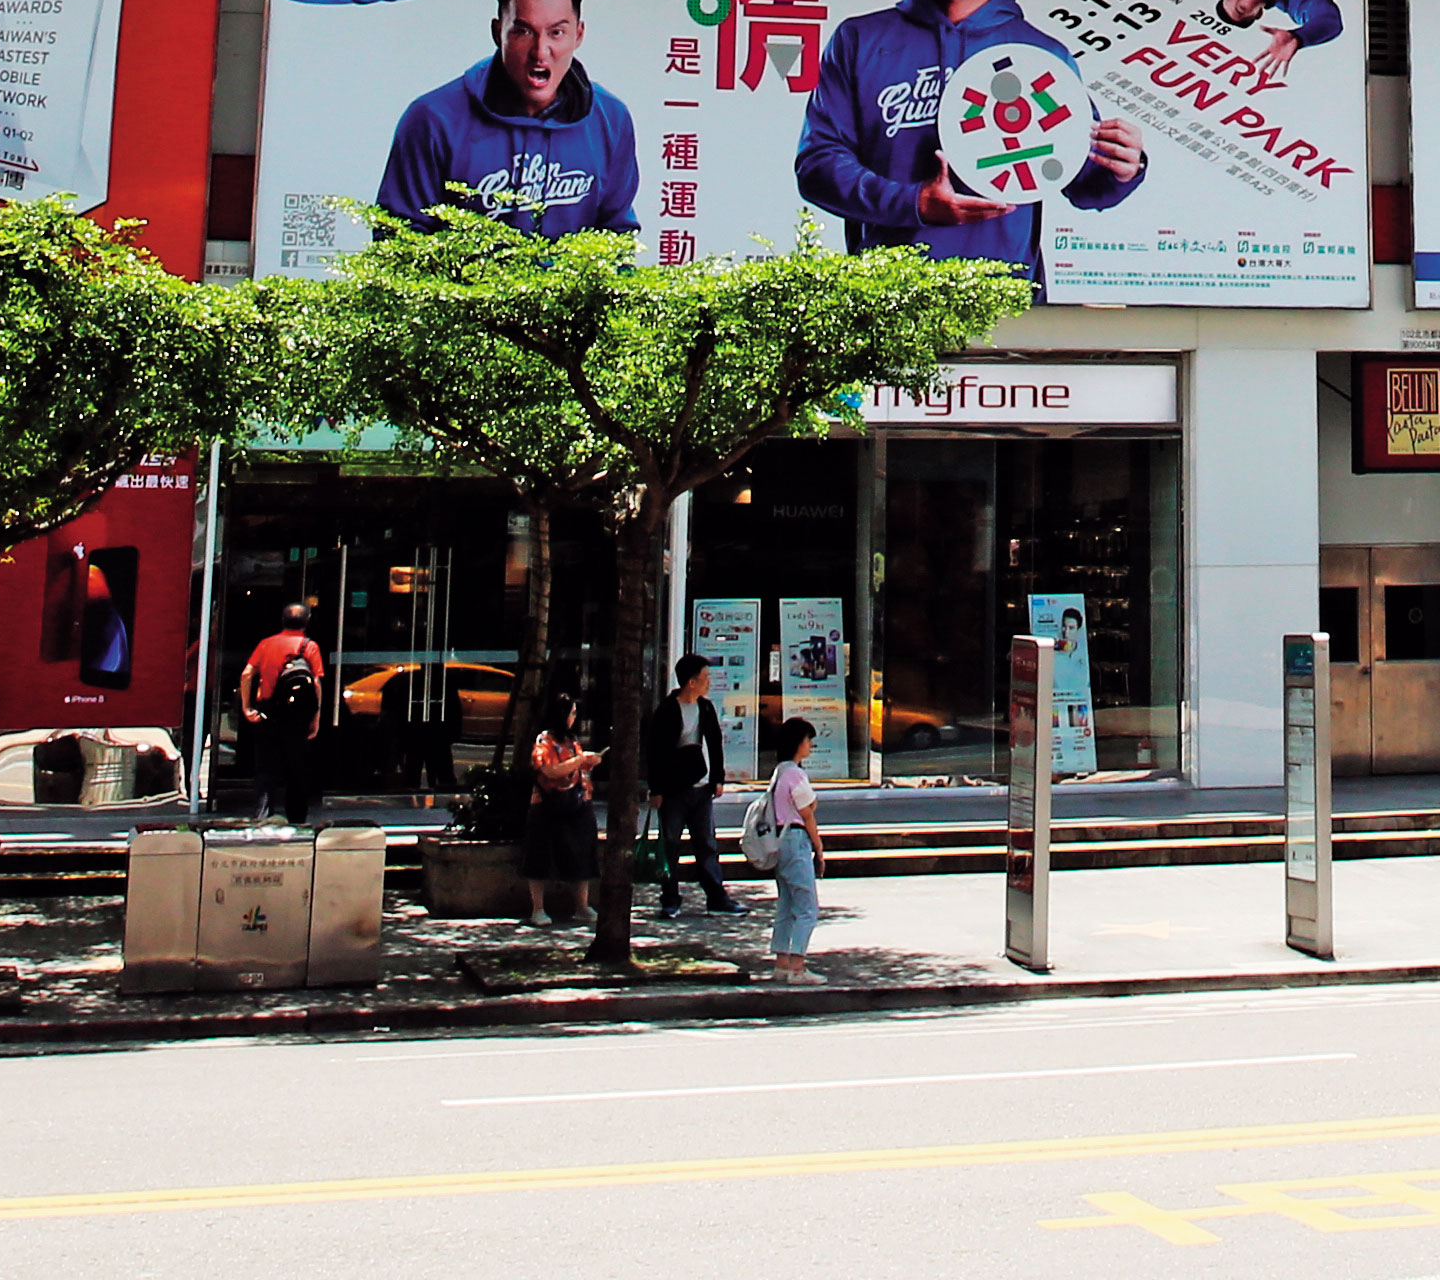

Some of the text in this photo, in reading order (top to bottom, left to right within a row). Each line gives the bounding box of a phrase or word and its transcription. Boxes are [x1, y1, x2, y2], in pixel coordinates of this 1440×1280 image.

[1190, 9, 1232, 36] 2018
[1166, 19, 1288, 96] VERY
[1121, 46, 1355, 190] FUN PARK
[1391, 373, 1437, 413] BELLINI
[773, 504, 845, 520] HUAWEI
